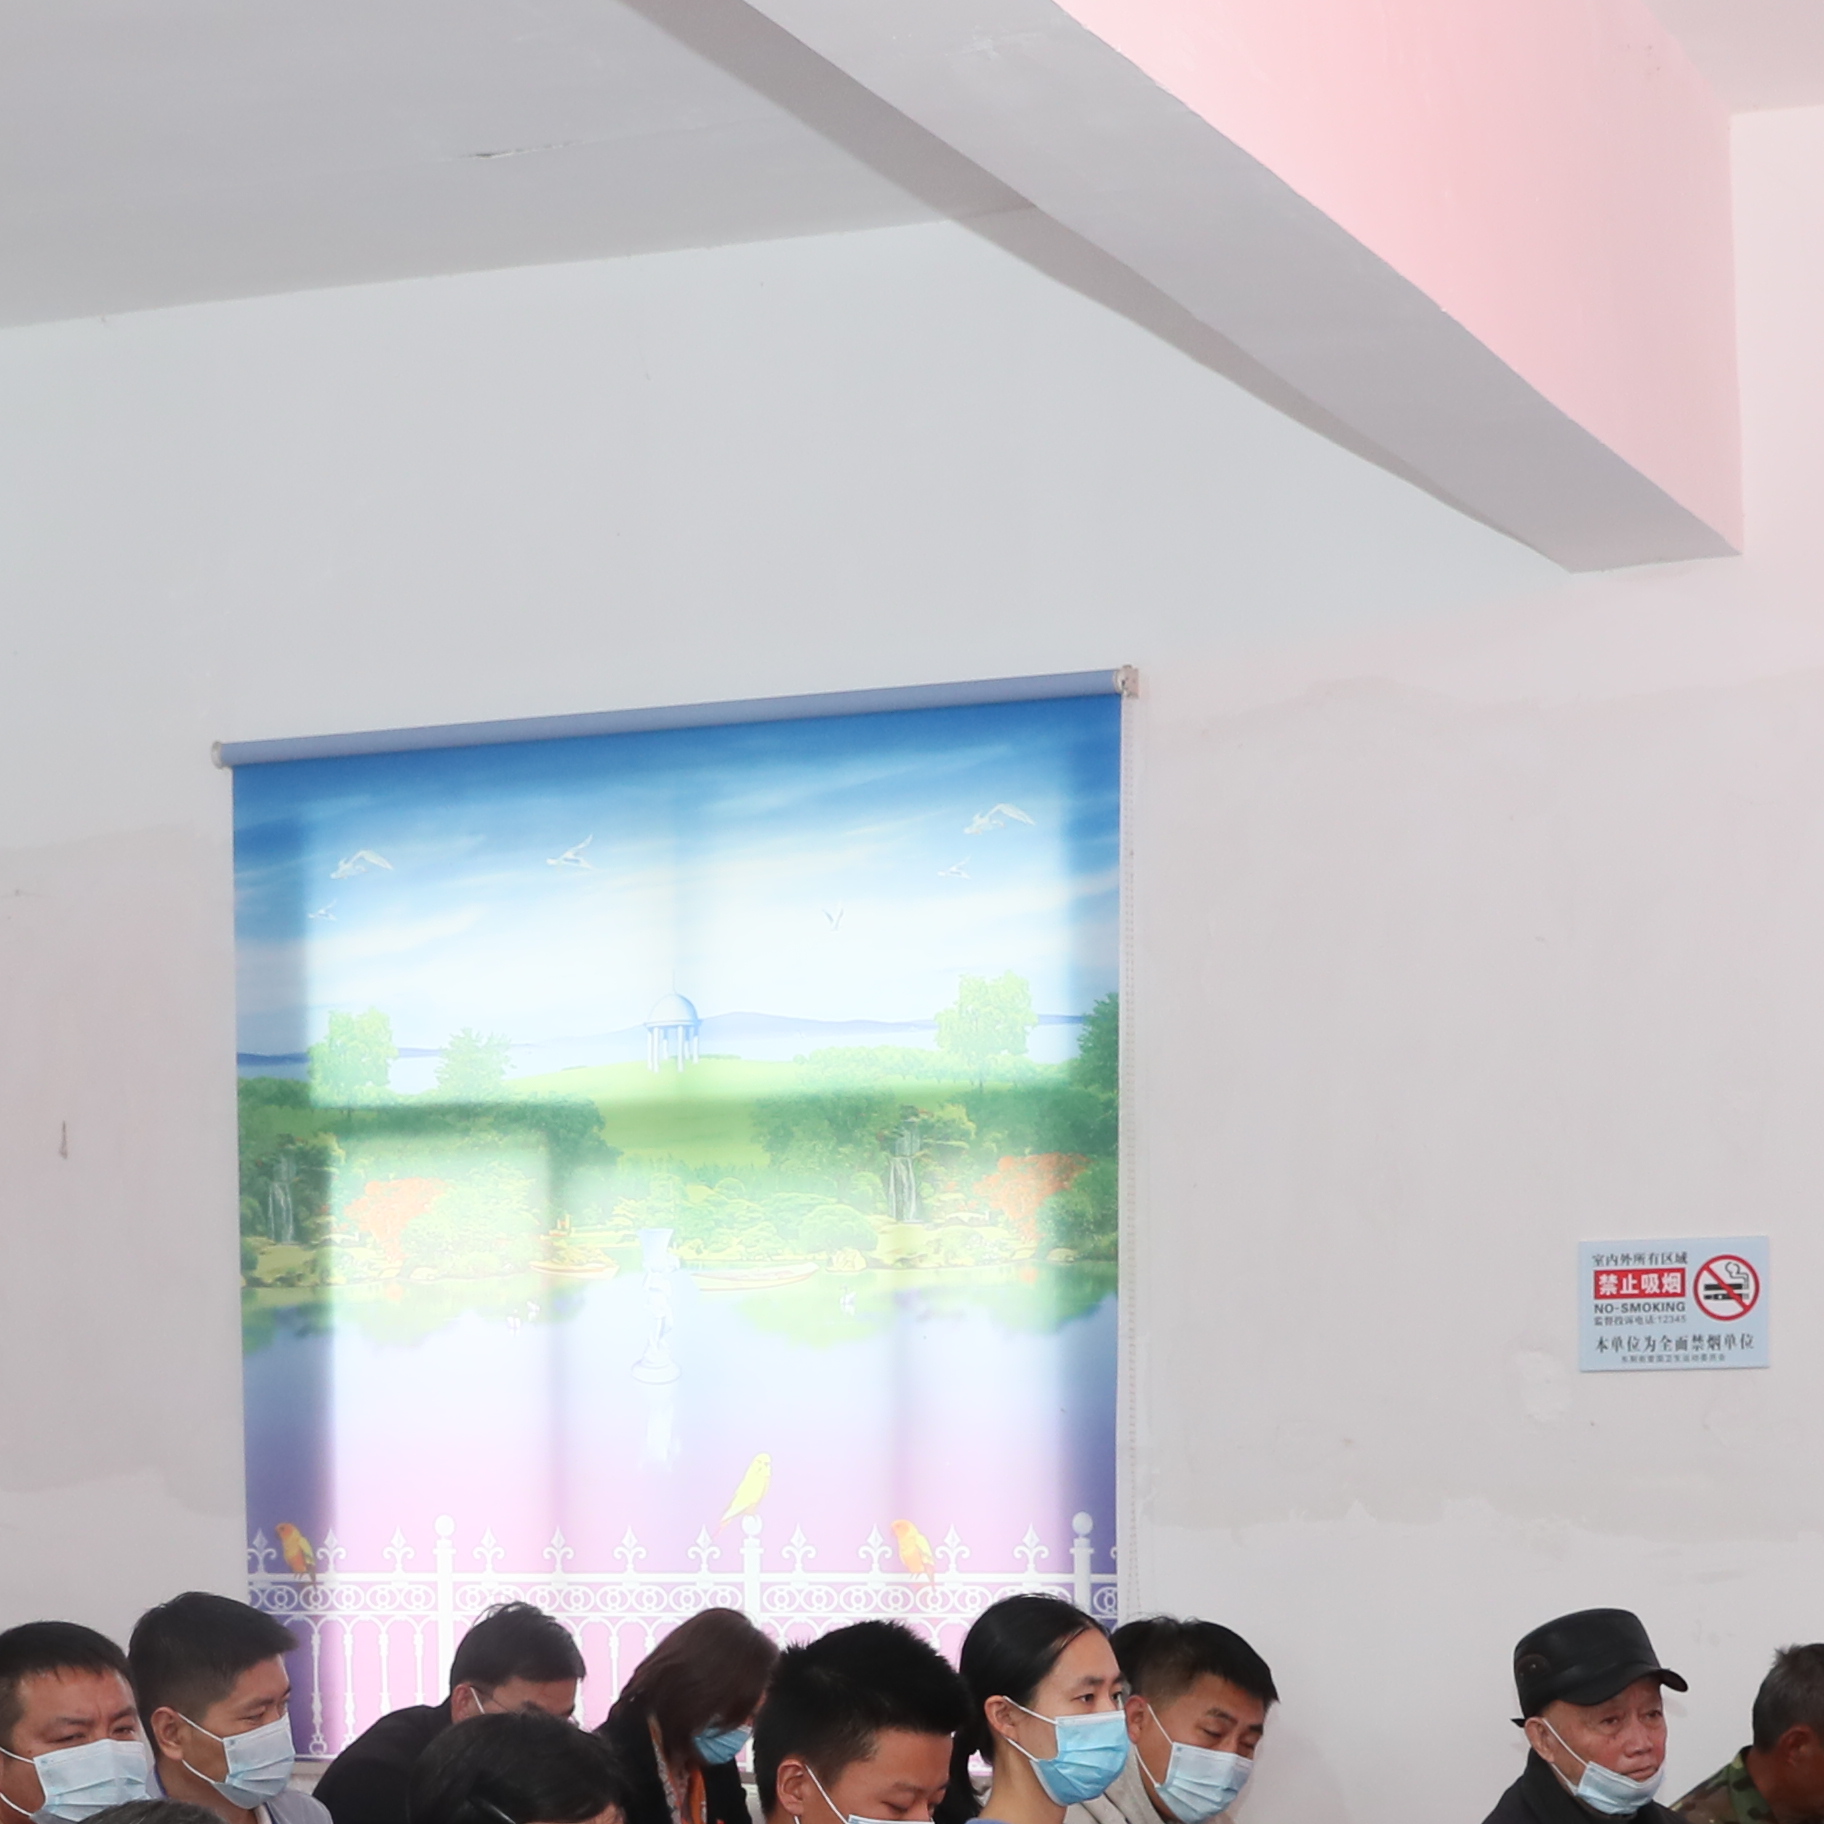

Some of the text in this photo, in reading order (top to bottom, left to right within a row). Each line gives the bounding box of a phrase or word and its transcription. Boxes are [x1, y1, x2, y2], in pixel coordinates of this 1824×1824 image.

[1592, 1251, 1688, 1267] 室内外所有区域
[1598, 1273, 1682, 1296] 禁止吸烟
[1594, 1301, 1685, 1314] NO-SMOKING
[1596, 1333, 1755, 1354] 本单位为全面禁烟单位
